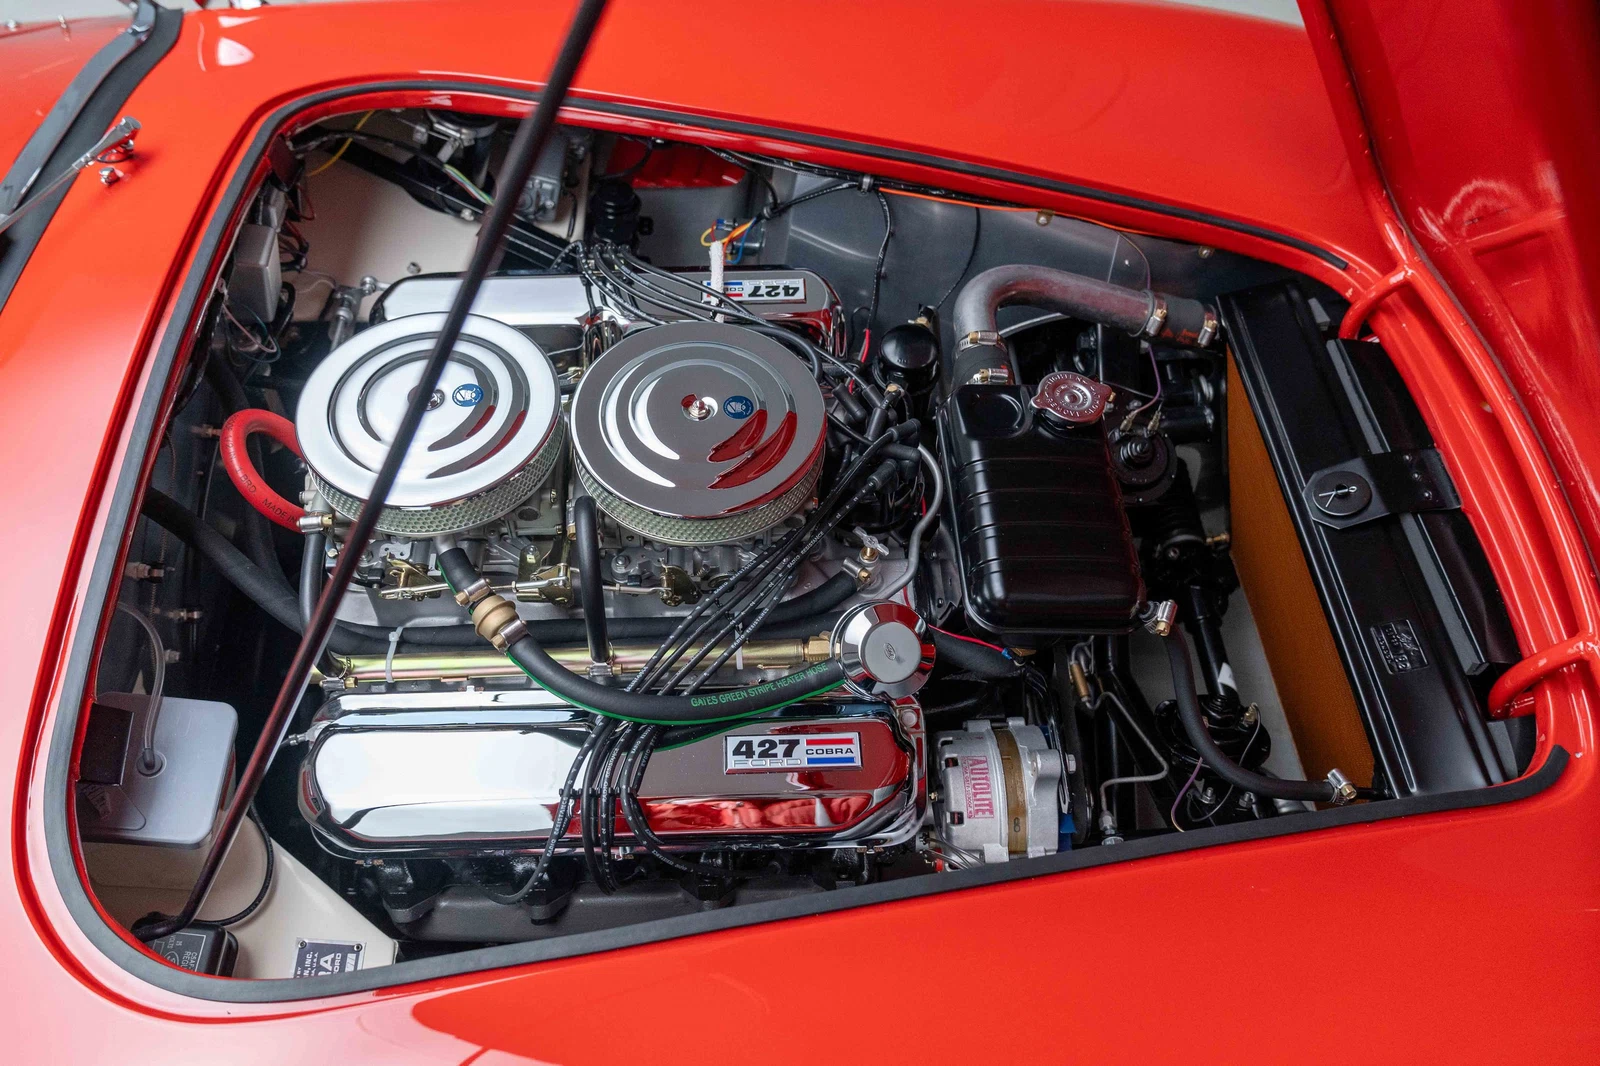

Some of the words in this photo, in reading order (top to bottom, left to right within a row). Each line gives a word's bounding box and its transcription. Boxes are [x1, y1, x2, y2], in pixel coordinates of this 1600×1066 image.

[748, 285, 800, 298] 427
[262, 498, 287, 519] MADE
[786, 554, 800, 568] RADIO
[800, 530, 824, 554] RESISTANCE
[730, 633, 745, 649] RADIO
[745, 606, 769, 633] RESISTANCE
[690, 695, 719, 708] GATES
[718, 690, 748, 704] GREEN
[749, 684, 777, 699] STRIPE
[777, 673, 805, 690] HEATER
[806, 662, 829, 677] HOSE
[732, 739, 801, 759] 427
[805, 747, 854, 755] COBRA
[733, 758, 802, 768] FORD
[601, 780, 609, 802] RADIO
[605, 747, 619, 777] RESISTANCE
[969, 758, 994, 818] AUTOLITE
[545, 838, 556, 857] RADIO
[553, 796, 569, 834] RESISTANCE
[305, 951, 314, 967] INC.
